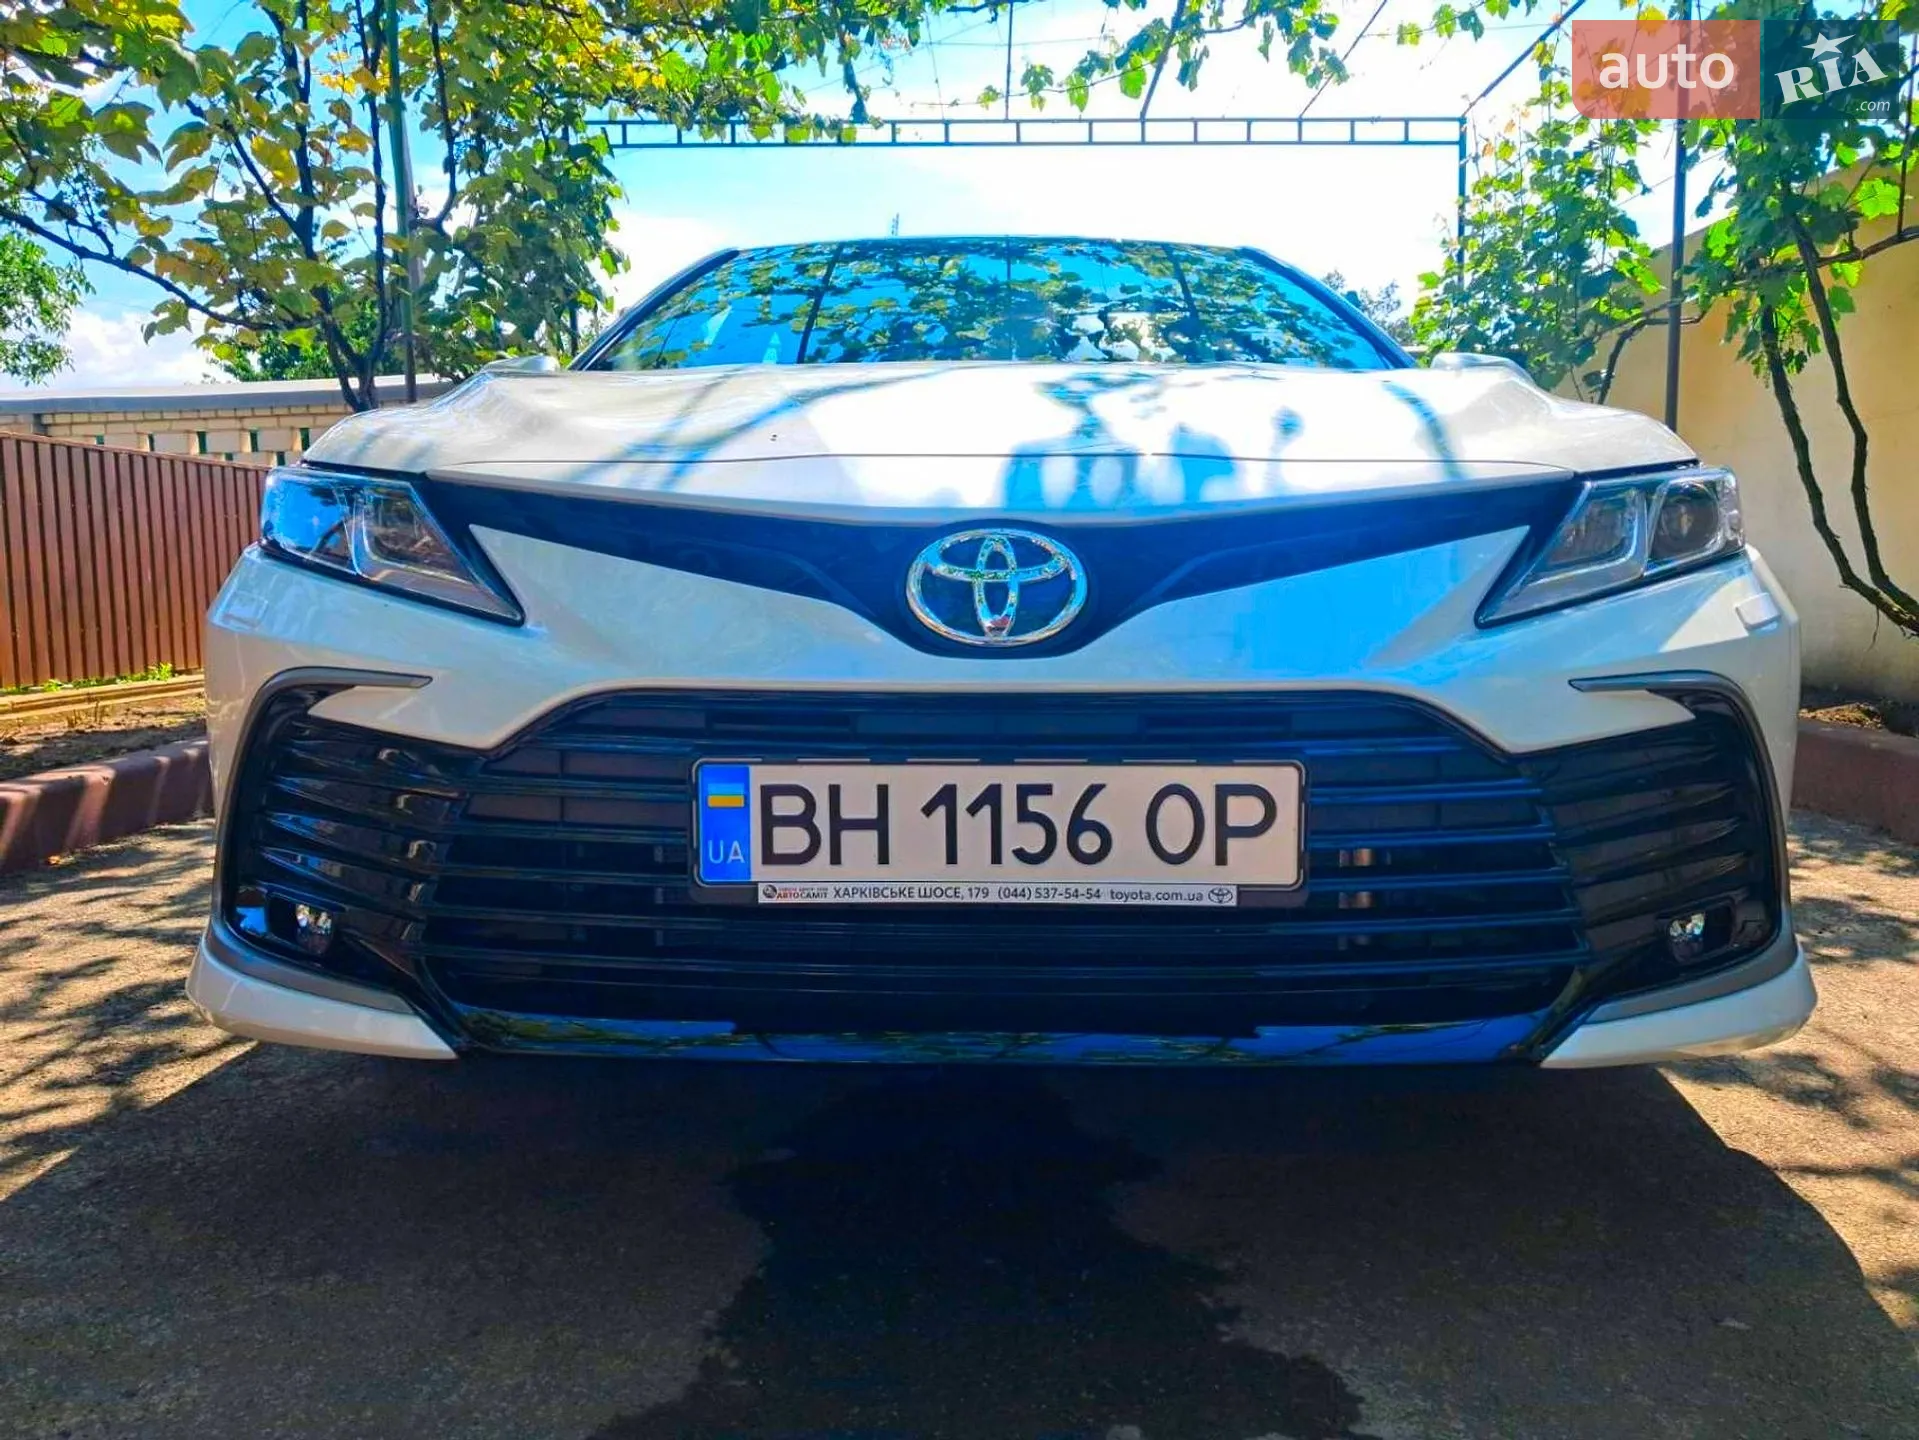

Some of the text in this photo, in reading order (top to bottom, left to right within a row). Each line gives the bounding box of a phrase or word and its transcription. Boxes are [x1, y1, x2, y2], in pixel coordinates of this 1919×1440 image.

[760, 783, 1277, 866] BH 1156 OP
[708, 840, 745, 864] UA
[833, 886, 1204, 903] ХАРКІВСЬКЕ ШОСЕ, 179 (044) 537-54-54 toyota.com.ua
